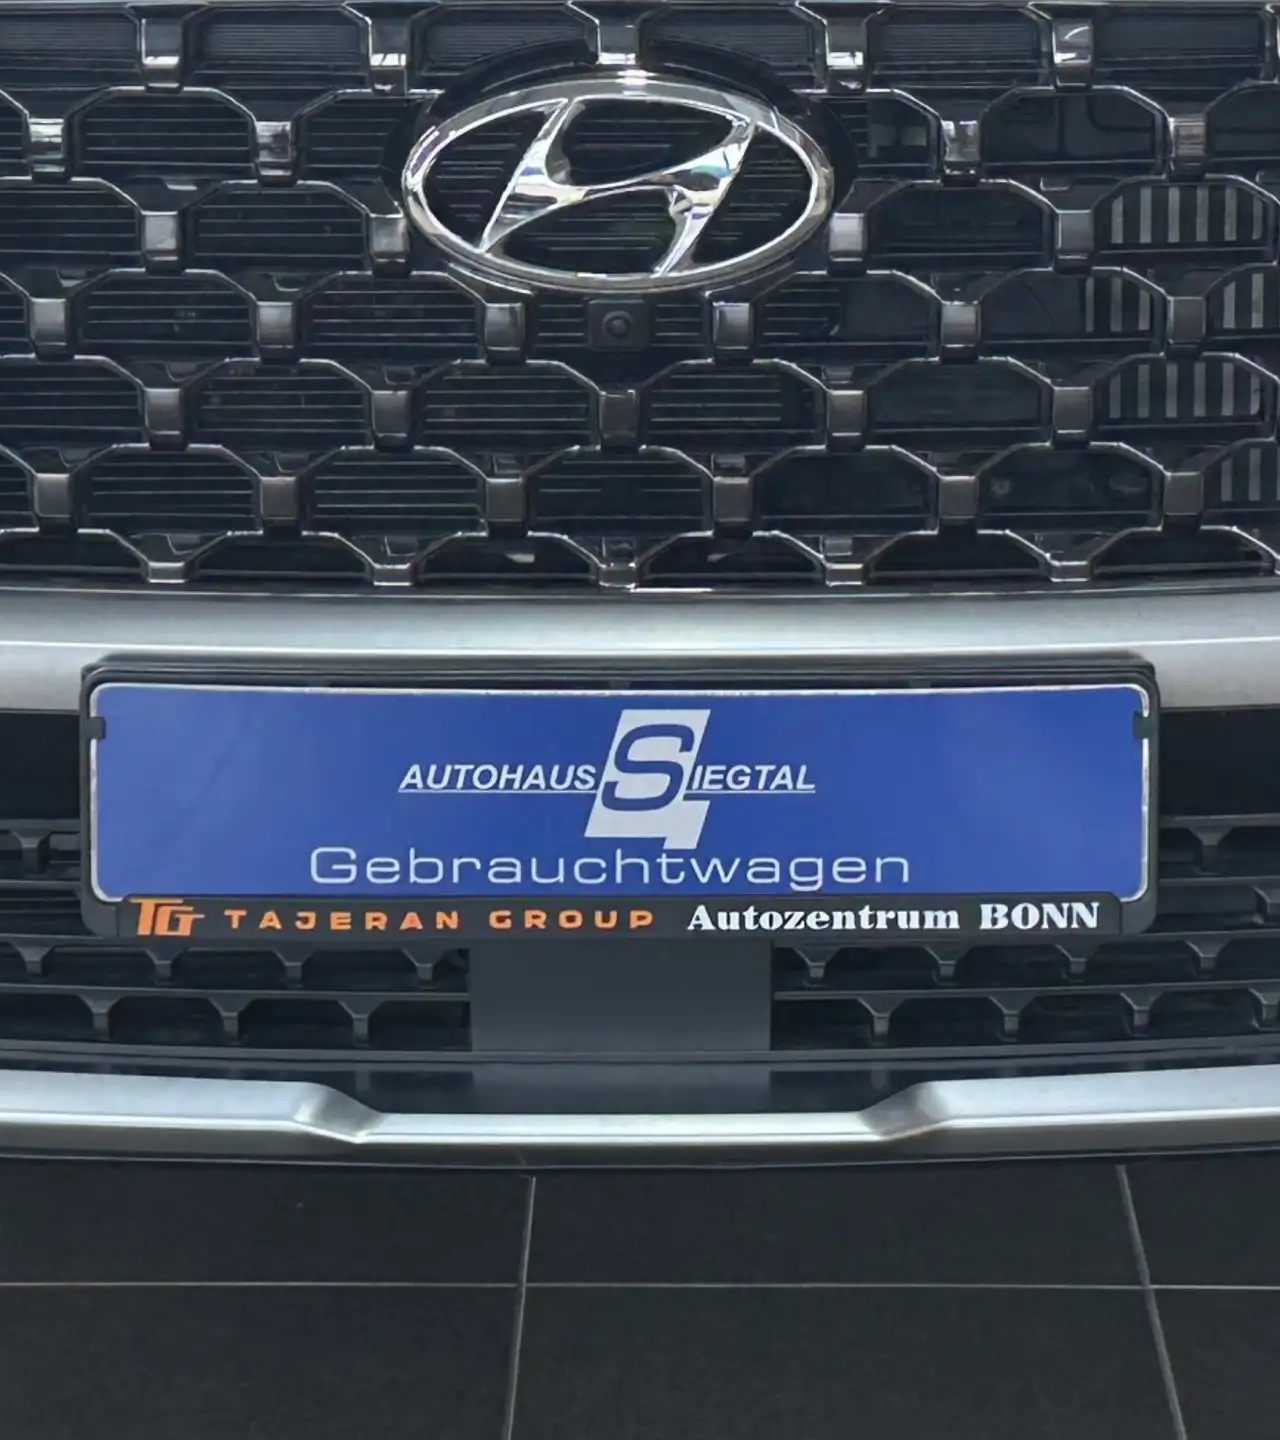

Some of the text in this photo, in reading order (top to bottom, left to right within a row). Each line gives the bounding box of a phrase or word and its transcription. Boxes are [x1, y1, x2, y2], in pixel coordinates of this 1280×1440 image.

[399, 723, 816, 812] AUTOHAUS SIEGTAL
[310, 846, 910, 892] Gebrauchtwagen
[224, 909, 459, 931] TAJERAN
[488, 909, 654, 930] GROUP
[686, 904, 961, 931] Autozentrum
[979, 902, 1101, 930] BONN
